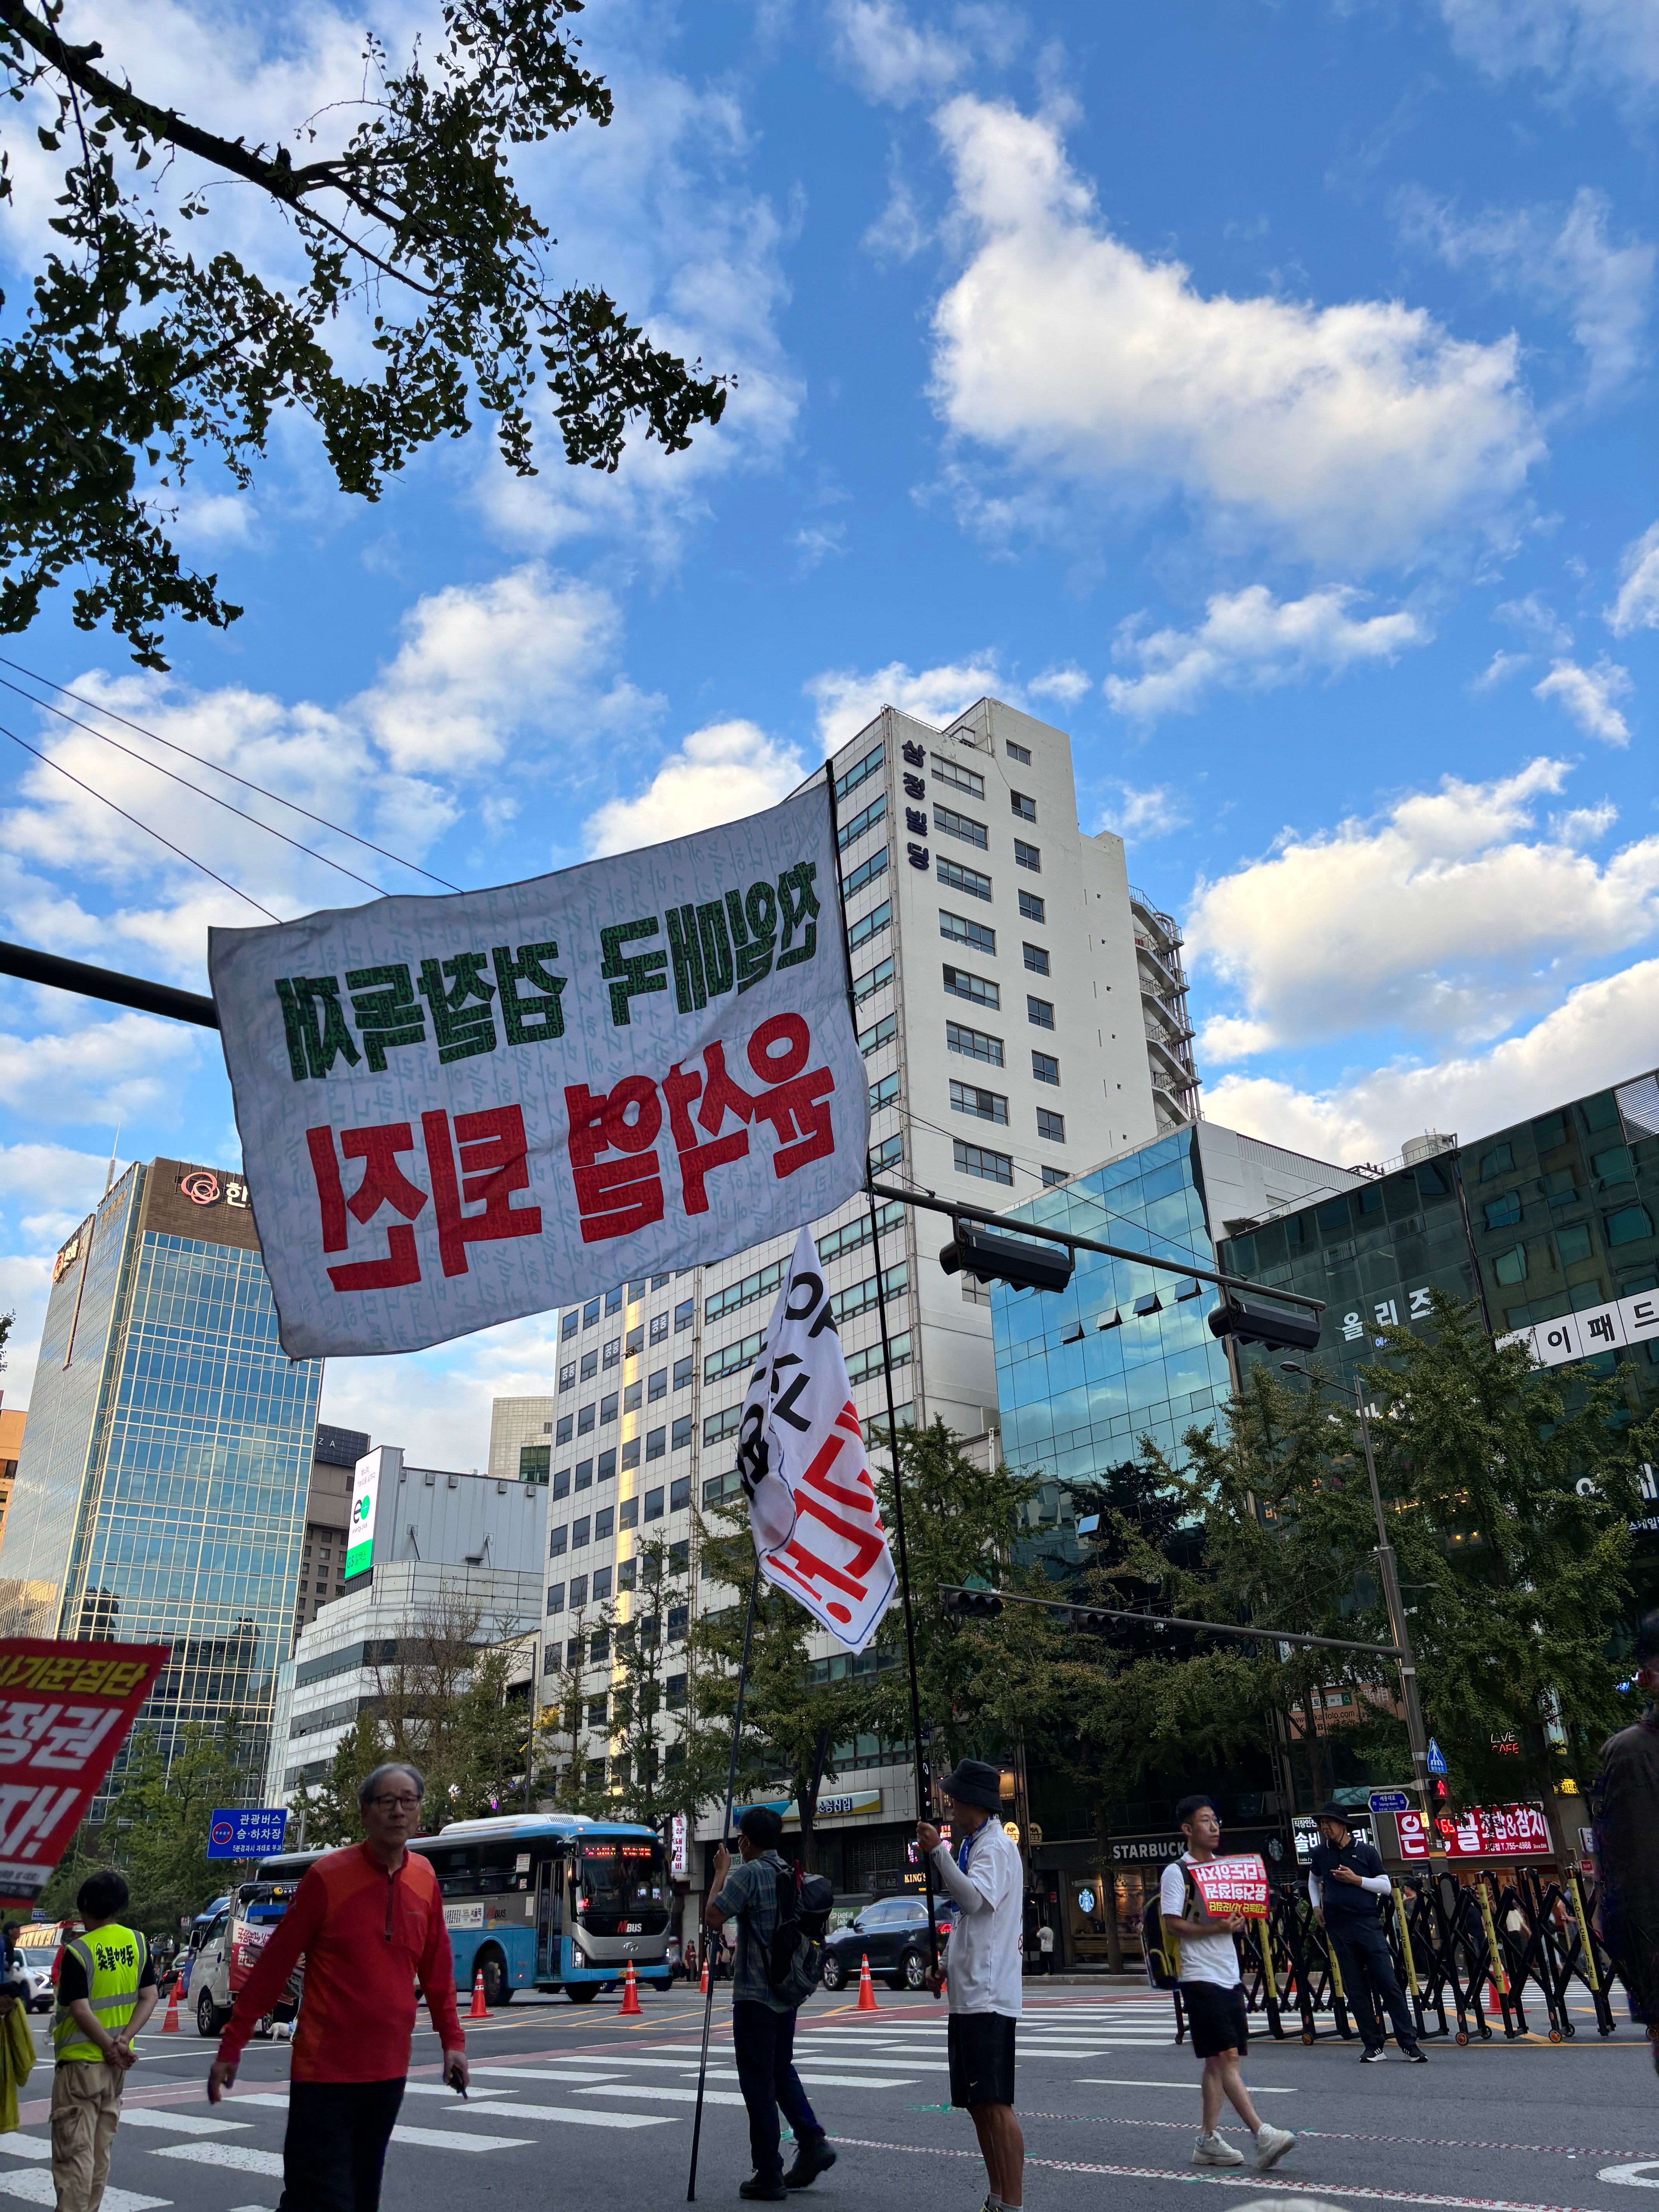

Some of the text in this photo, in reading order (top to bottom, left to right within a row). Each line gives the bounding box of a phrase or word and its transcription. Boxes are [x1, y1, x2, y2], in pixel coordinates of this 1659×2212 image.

[902, 740, 929, 870] 삼정빌딩
[1342, 1287, 1436, 1341] 올리즈
[1547, 1302, 1659, 1353] 이패드
[0, 1700, 124, 1771] 정권
[237, 1828, 281, 1839] 승·하차장
[240, 1814, 281, 1825] 관광버스
[1401, 1812, 1480, 1853] 은골
[1113, 1841, 1186, 1859] STARBUCK
[1195, 1864, 1258, 1882] 타도하자!
[1204, 1883, 1266, 1901] 윤건희정권
[1573, 1898, 1594, 1979] POLICE LINE
[96, 1943, 134, 1972] 촛불행동
